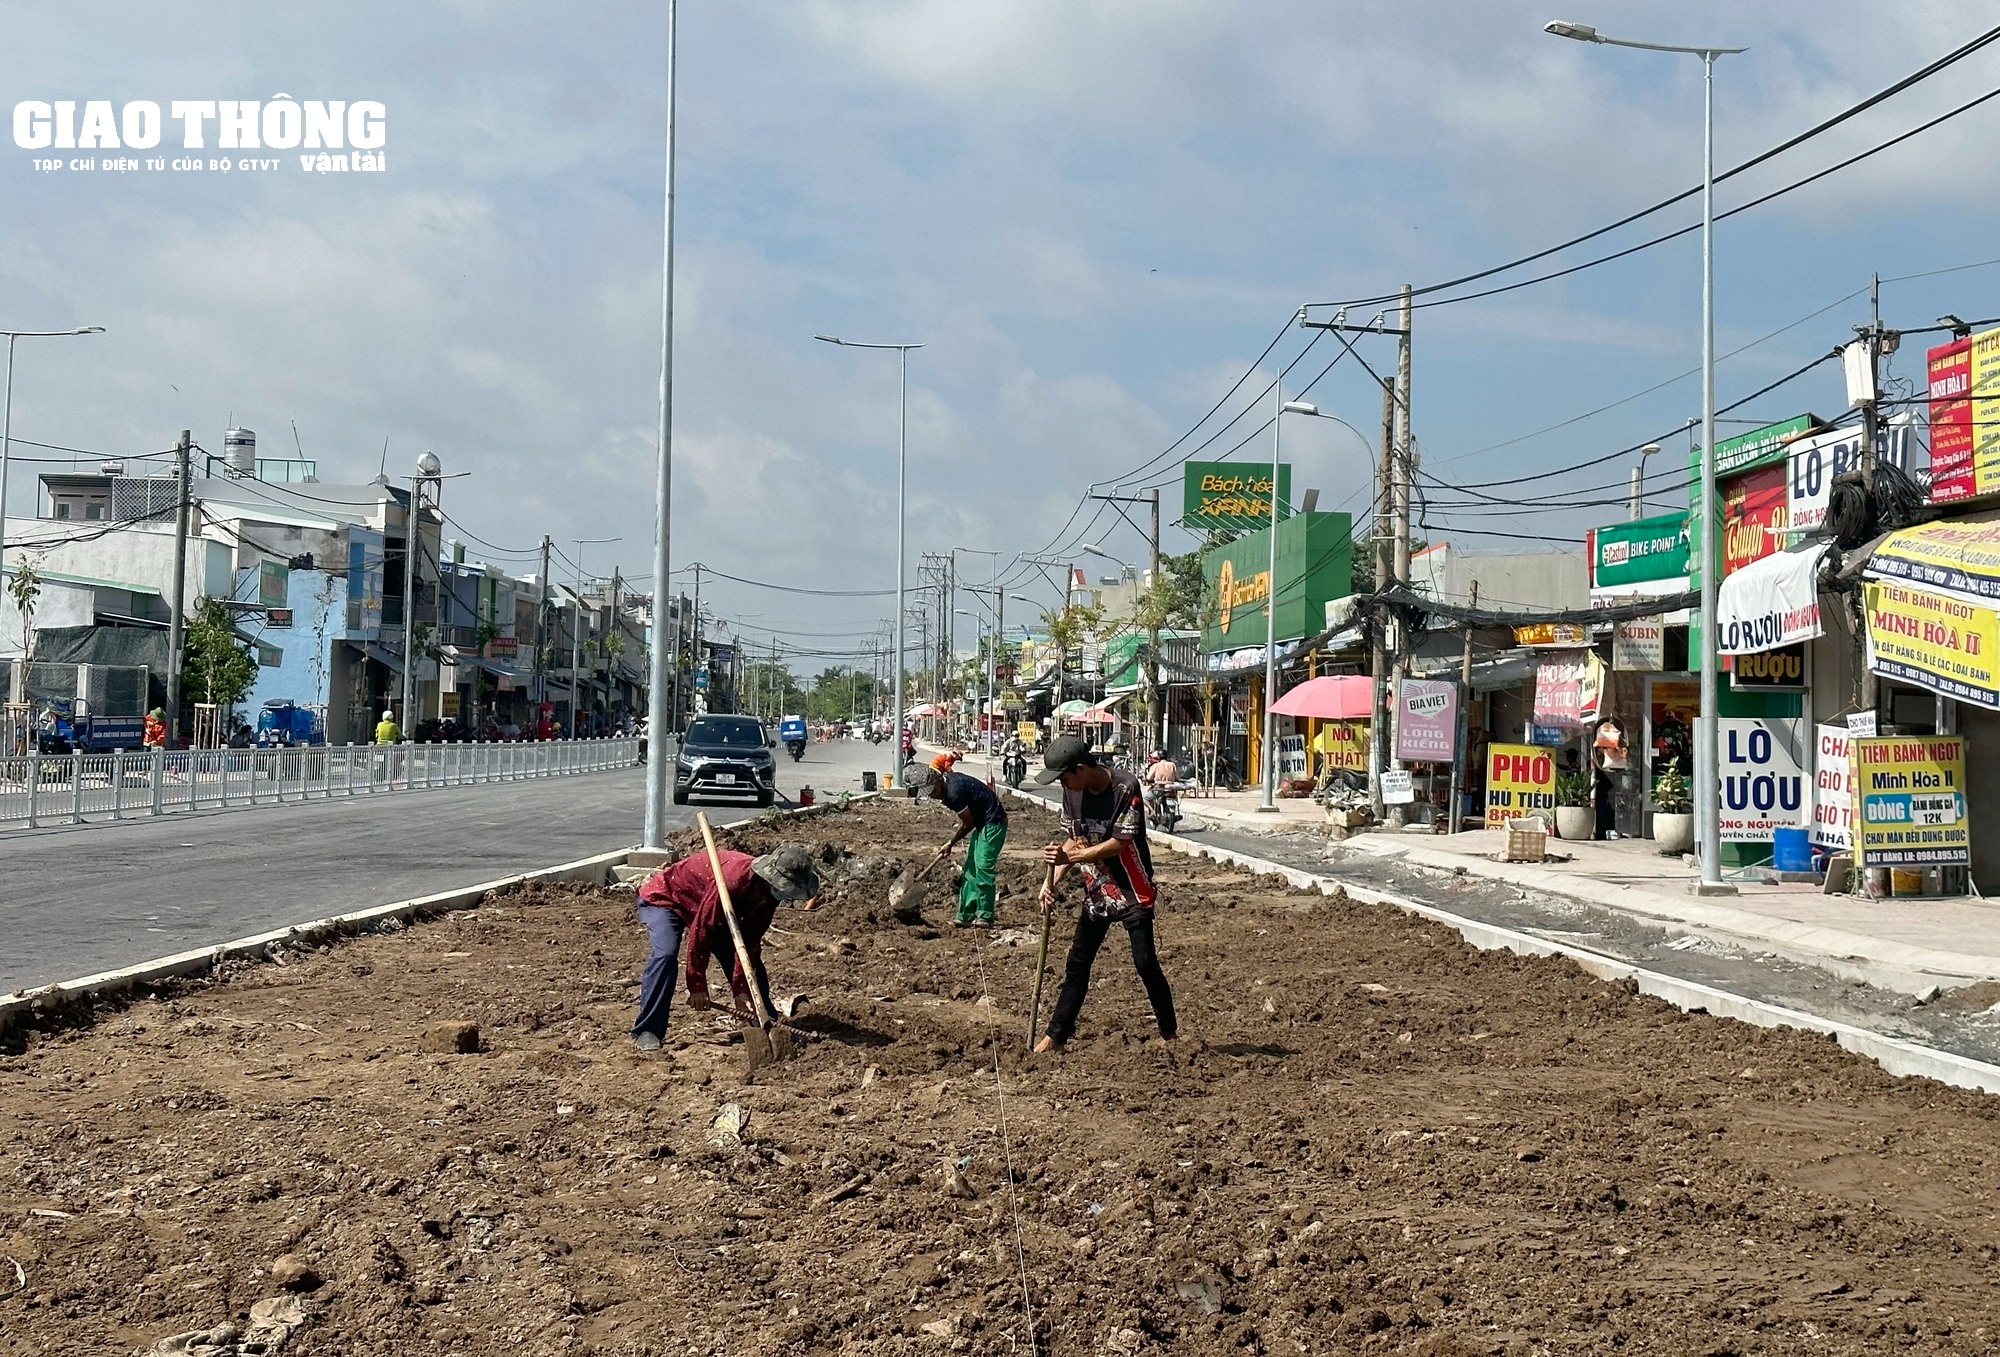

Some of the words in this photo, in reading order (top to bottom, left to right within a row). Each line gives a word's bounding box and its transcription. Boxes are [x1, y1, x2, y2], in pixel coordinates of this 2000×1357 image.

[1930, 379, 1946, 399] MINH
[1794, 439, 1821, 499] LÒ
[1201, 475, 1243, 492] Bách
[1199, 497, 1273, 517] XANH
[1728, 513, 1765, 565] Thuận
[1606, 542, 1628, 564] Castrol
[1631, 541, 1648, 557] BIKE
[1651, 536, 1676, 554] POINT
[1883, 585, 1908, 604] TIỆM
[1912, 591, 1941, 612] BÁNH
[1945, 601, 1975, 621] NGỌT
[1620, 627, 1659, 639] SUBIN
[1717, 615, 1740, 650] LÒ
[1741, 610, 1782, 650] RƯỢU
[1873, 609, 1919, 639] MINH
[1923, 618, 1960, 651] HÒA
[1965, 631, 1982, 656] II
[1739, 652, 1801, 683] RƯỢU
[1896, 643, 1914, 659] HÀNG
[1970, 666, 1990, 682] BÁNH
[1410, 698, 1426, 710] BIA
[1426, 694, 1445, 708] VIỆT
[1982, 691, 1994, 703] 515
[1332, 724, 1356, 744] NỘI
[1403, 729, 1443, 738] LONG
[1728, 720, 1772, 764] LÒ
[1327, 747, 1362, 766] THẤT
[1861, 741, 1889, 767] TIỆM
[1893, 740, 1925, 763] BÁNH
[1929, 742, 1960, 764] NGỌT
[1493, 751, 1552, 784] PHỞ
[1818, 767, 1842, 791] GIÒ
[1872, 771, 1907, 789] Minh
[1912, 770, 1940, 788] Hòa
[1945, 770, 1953, 786] II
[1489, 787, 1511, 807] HỦ
[1518, 788, 1553, 809] TIẾU
[1913, 799, 1928, 810] BÁNH
[1929, 796, 1943, 810] ĐỒNG
[1815, 801, 1838, 825] GIÒ
[1868, 797, 1905, 821] ĐỒNG
[1923, 812, 1942, 824] 12K
[1746, 829, 1769, 839] CHẤT
[1816, 826, 1845, 845] NHÀ
[1866, 832, 1885, 844] CHAY
[1887, 830, 1904, 845] MẶN
[1945, 829, 1966, 844] ĐƯỢC
[1866, 851, 1881, 864] ĐẶT
[1882, 850, 1902, 863] HÀNG
[1904, 852, 1916, 861] LH:
[1916, 849, 1967, 861] 0984.895.515
